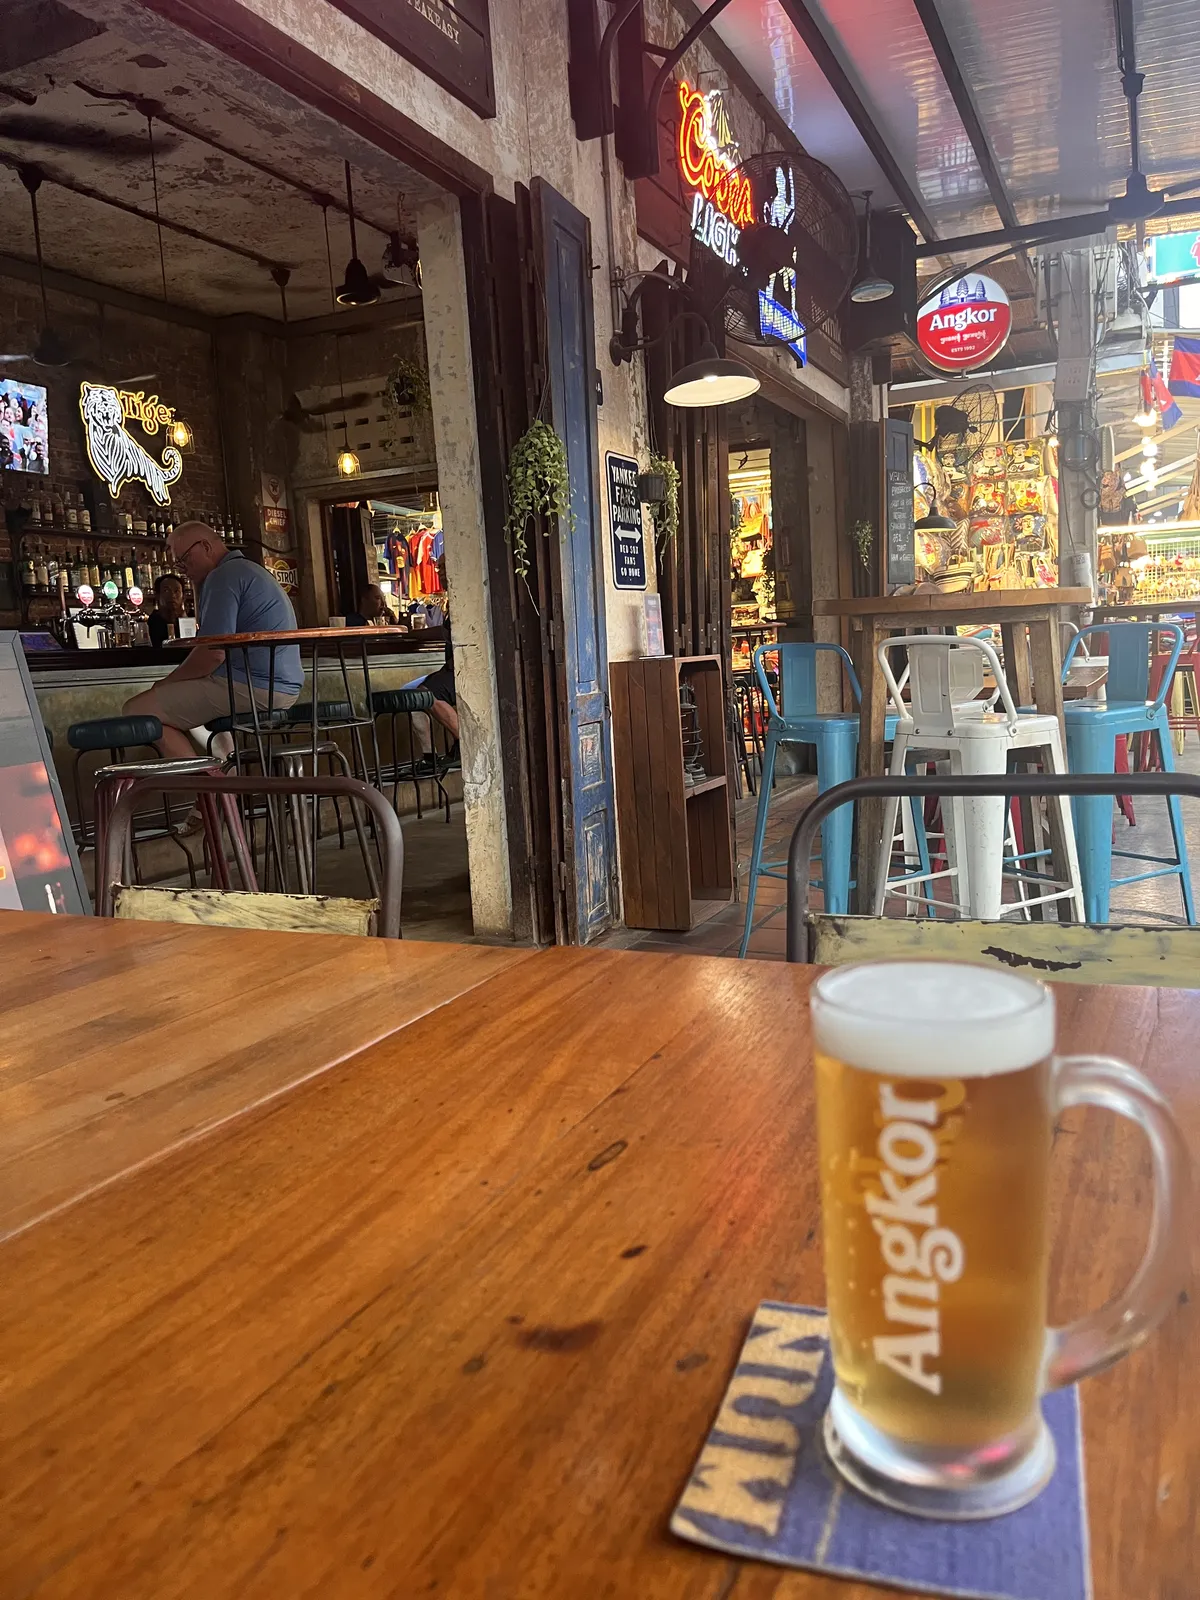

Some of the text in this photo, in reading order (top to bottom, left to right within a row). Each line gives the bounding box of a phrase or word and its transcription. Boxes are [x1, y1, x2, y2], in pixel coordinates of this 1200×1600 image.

[691, 191, 745, 272] LIGH
[929, 307, 998, 331] Angkor
[611, 465, 638, 488] YANKEE
[615, 486, 636, 506] FANS
[267, 508, 287, 519] DIESEL
[269, 517, 286, 526] CHIEF
[612, 504, 641, 526] PARKING
[624, 555, 636, 566] FANS
[620, 567, 641, 577] GO HOME
[865, 1083, 965, 1396] Angkor
